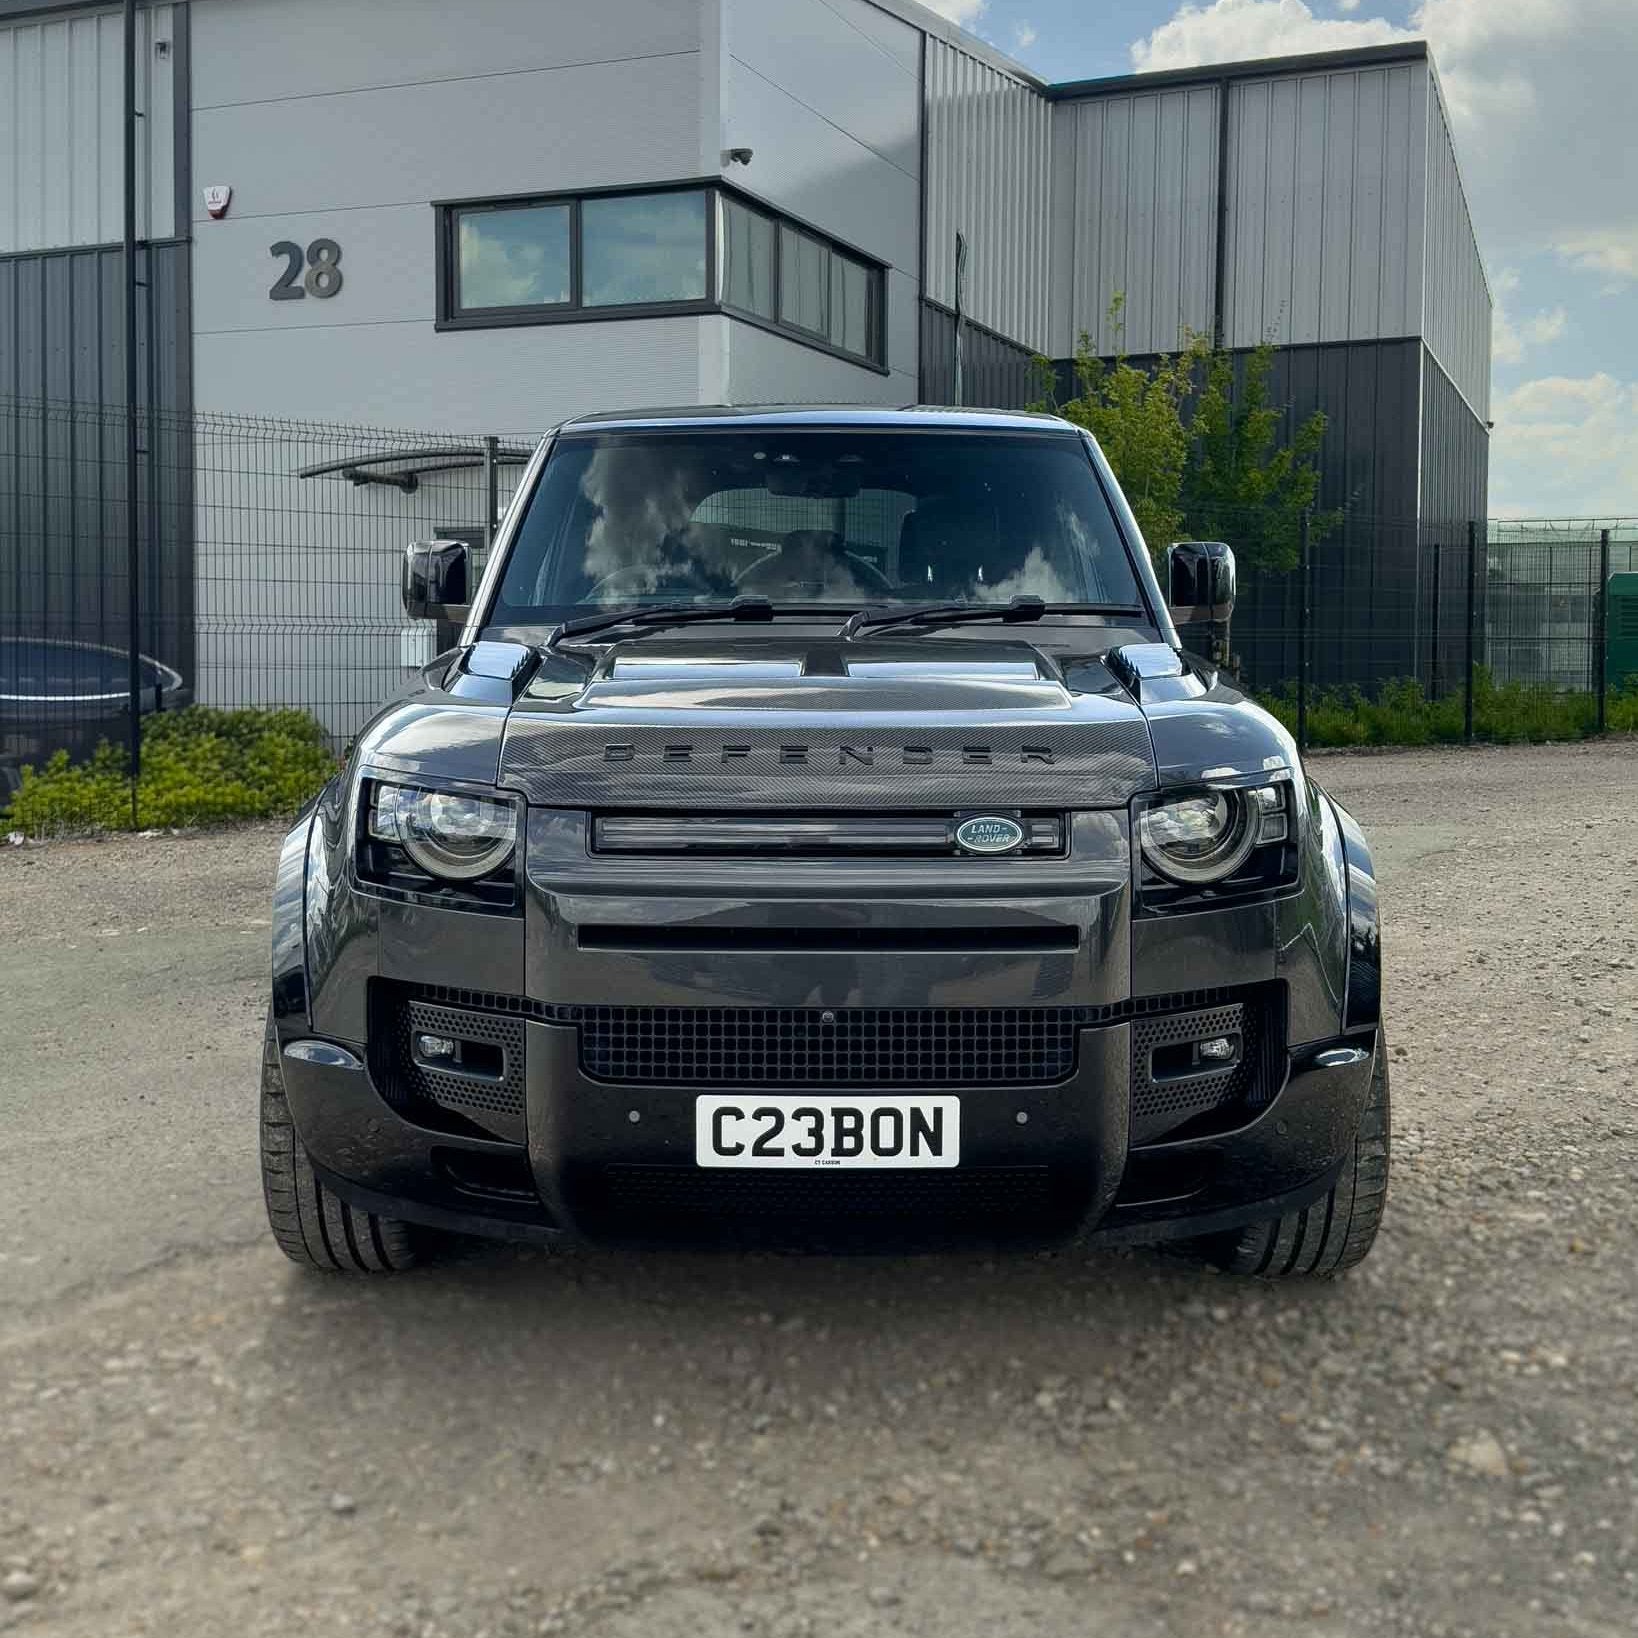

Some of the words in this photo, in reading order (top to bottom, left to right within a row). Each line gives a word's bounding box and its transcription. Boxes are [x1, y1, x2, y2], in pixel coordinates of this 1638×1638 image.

[269, 238, 343, 300] 28
[602, 743, 1055, 765] DEFENDER
[712, 1106, 943, 1157] C23BON
